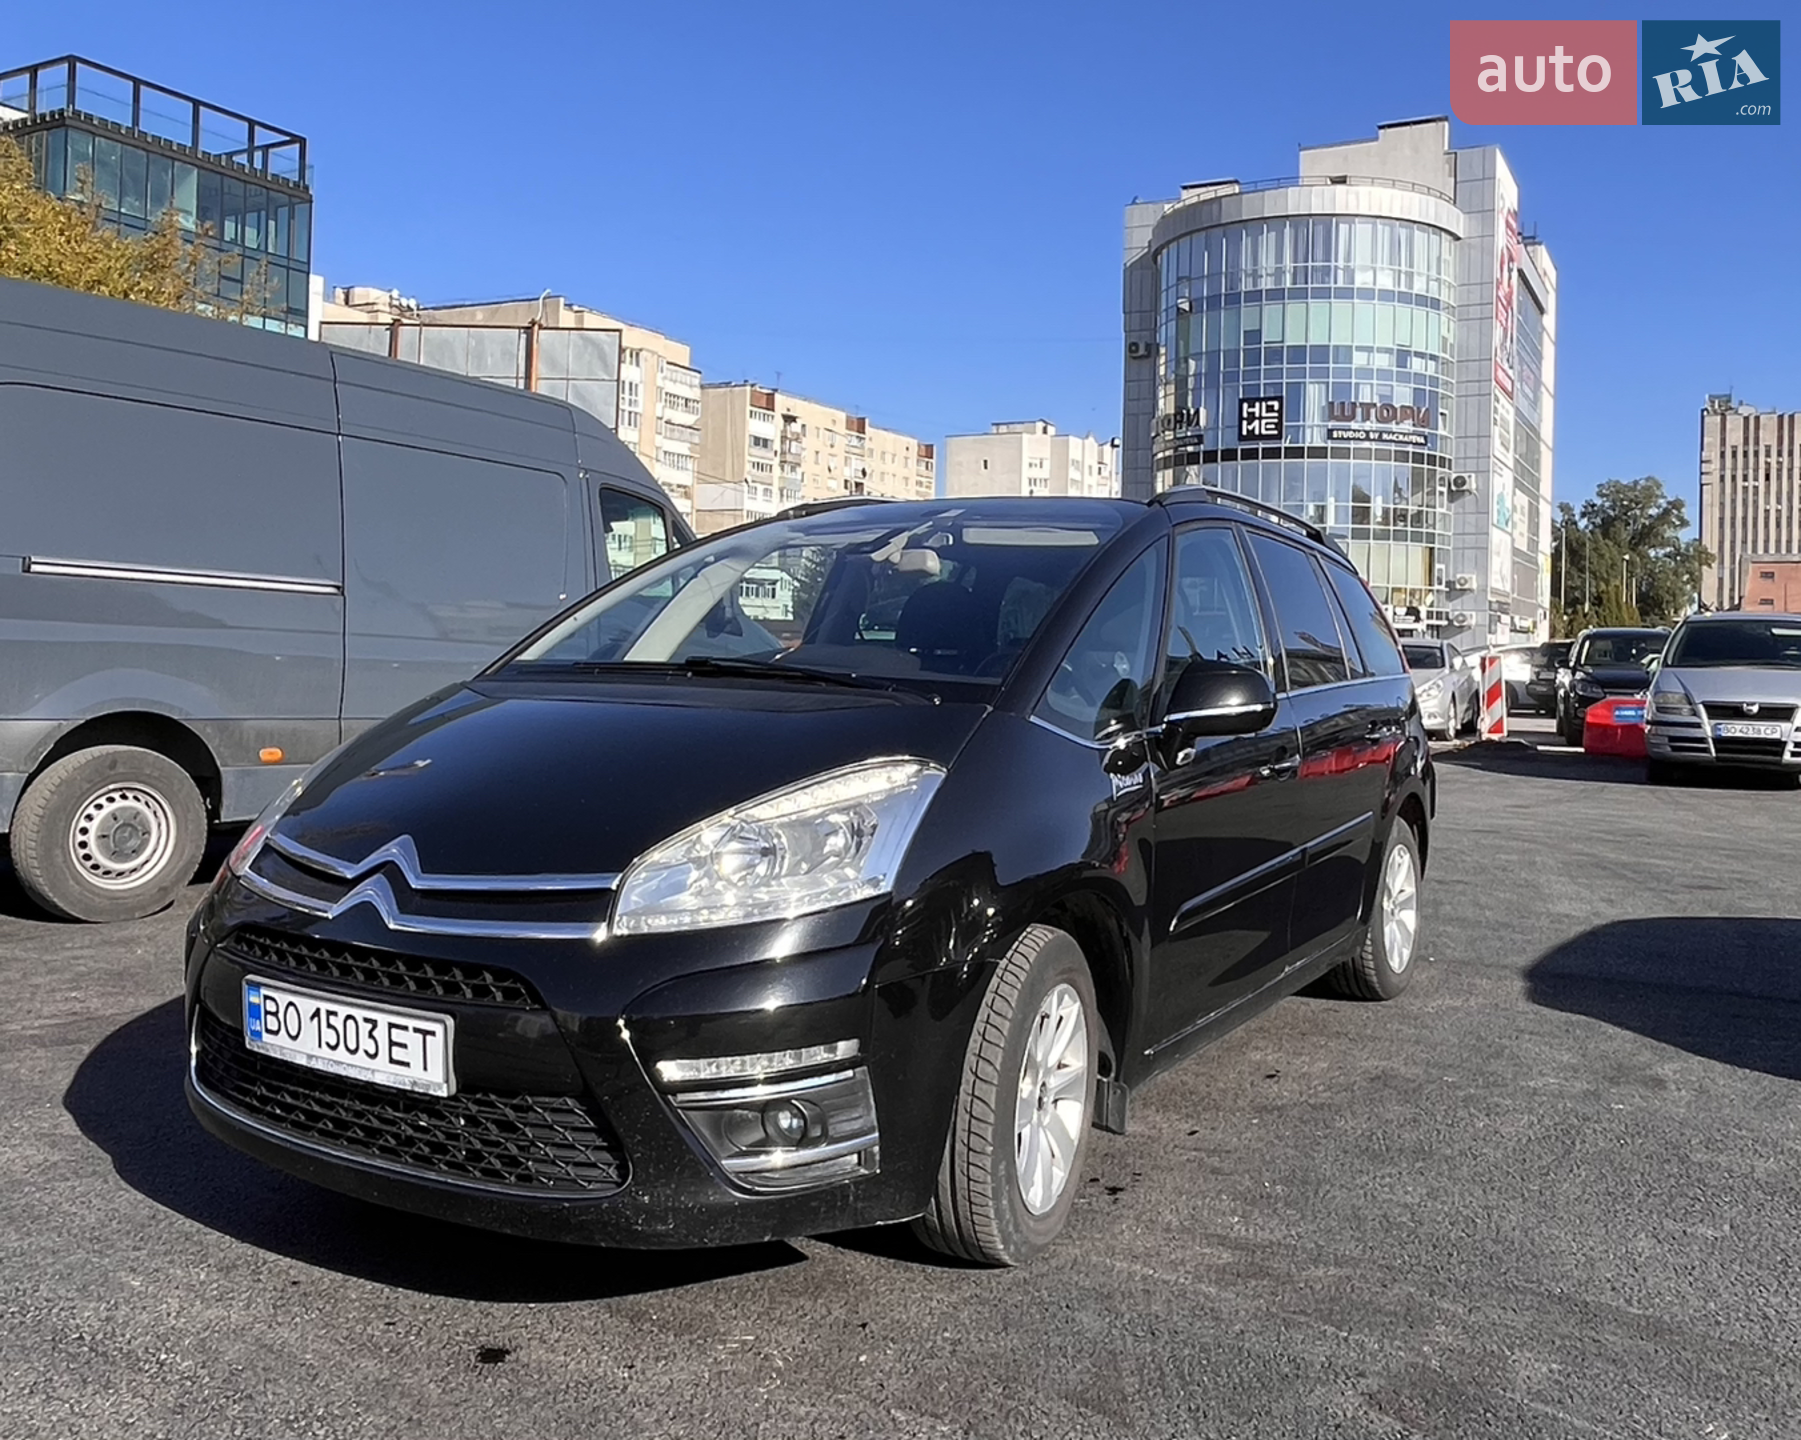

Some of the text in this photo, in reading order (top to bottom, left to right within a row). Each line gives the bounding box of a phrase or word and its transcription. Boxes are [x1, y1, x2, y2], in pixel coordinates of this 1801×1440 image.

[1328, 401, 1430, 428] ШТОРИ
[1332, 430, 1366, 439] STUDIO
[249, 1018, 262, 1032] UA
[262, 994, 302, 1041] BO
[310, 1007, 379, 1060] 1503
[388, 1022, 436, 1072] ET
